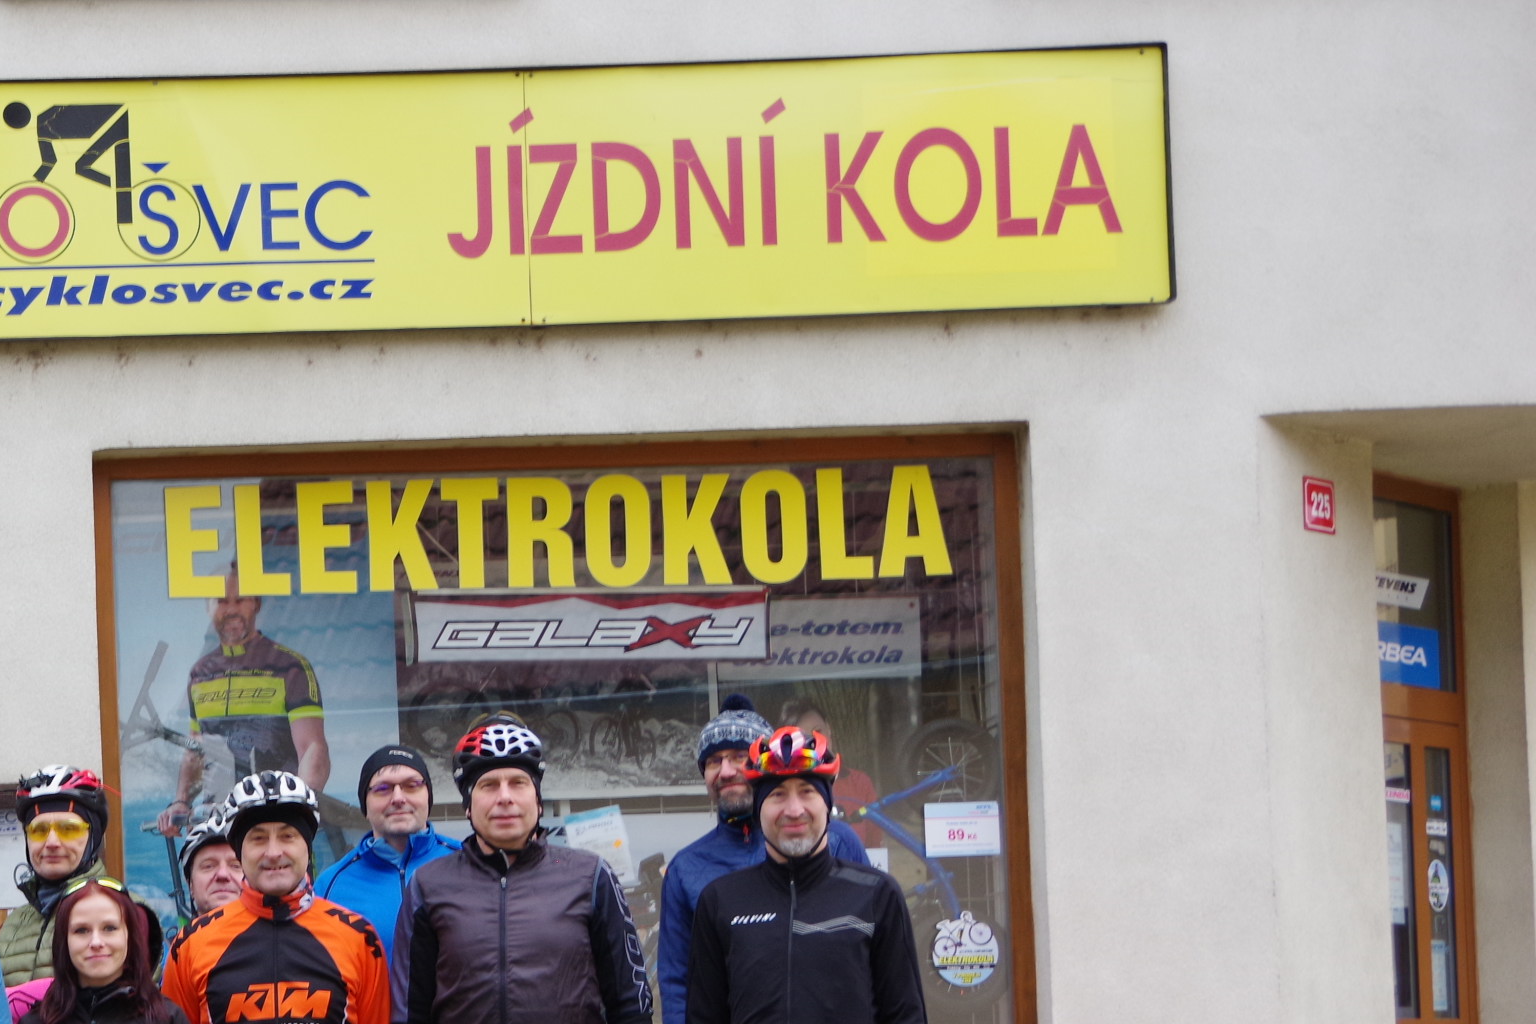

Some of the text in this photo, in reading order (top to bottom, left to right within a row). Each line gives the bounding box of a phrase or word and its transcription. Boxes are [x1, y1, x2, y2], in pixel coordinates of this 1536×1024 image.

[447, 97, 1124, 259] JÍZDNÍ KOLA
[137, 162, 374, 256] ŠVEC
[1311, 491, 1331, 519] 225
[163, 463, 953, 599] ELEKTROKOLA
[431, 614, 755, 653] GALAXY
[948, 829, 965, 841] 89
[225, 981, 332, 1023] KTM
